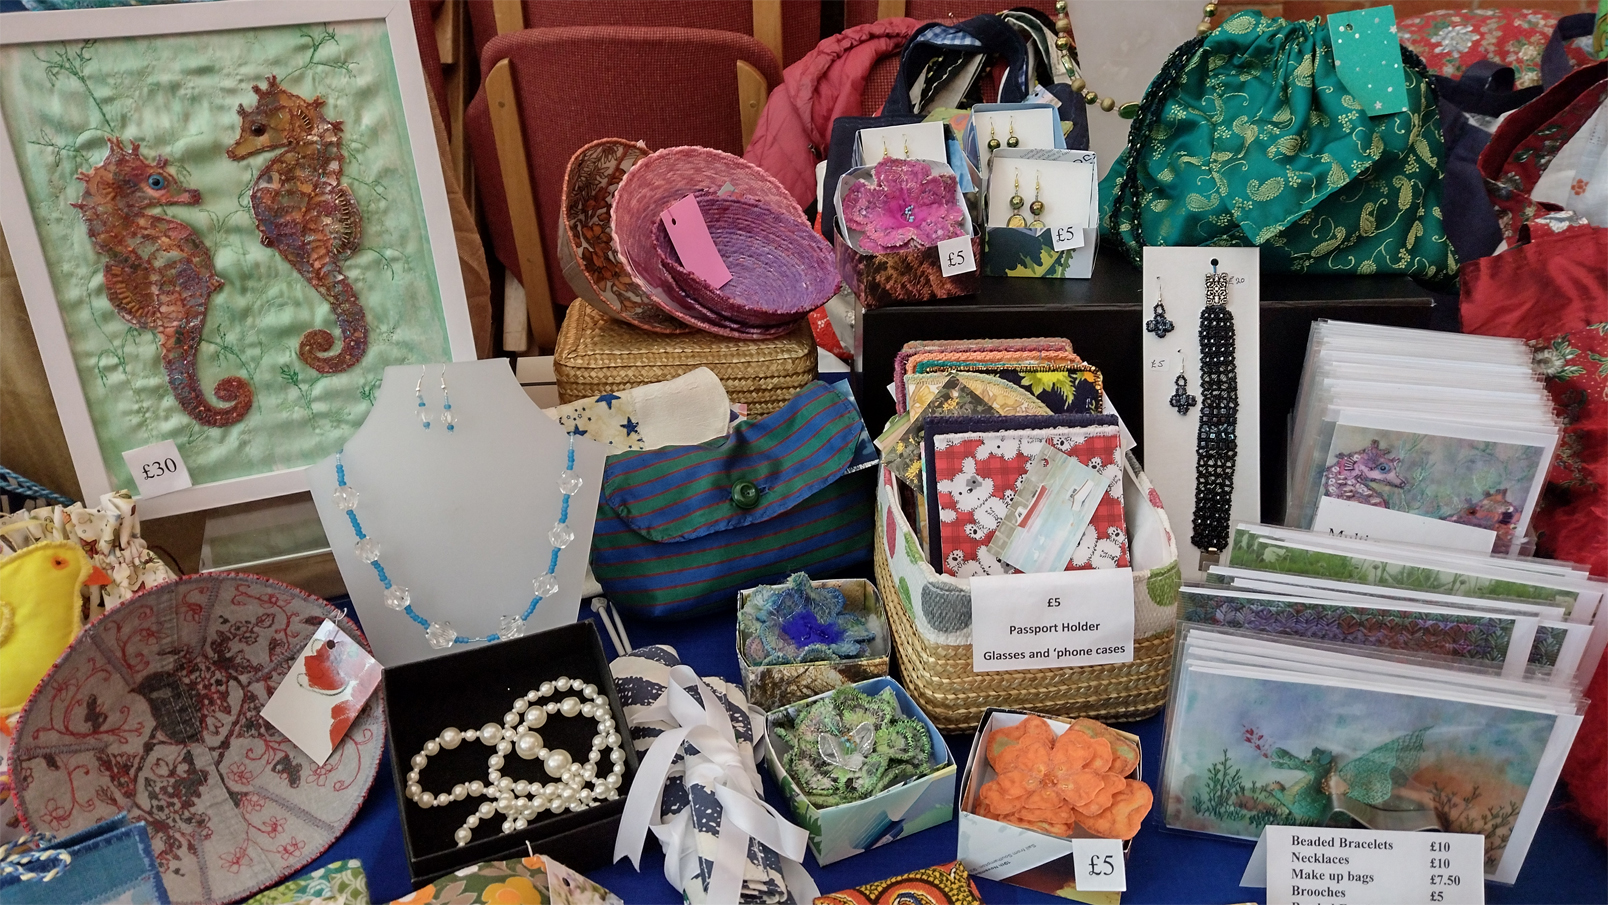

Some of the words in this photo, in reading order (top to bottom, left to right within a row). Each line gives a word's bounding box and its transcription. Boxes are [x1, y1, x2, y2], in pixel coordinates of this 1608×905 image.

[1056, 226, 1075, 242] £5
[947, 250, 965, 267] £5
[1151, 359, 1165, 368] £5
[142, 457, 177, 480] £30
[1047, 597, 1061, 608] £5
[1009, 623, 1058, 636] Passport
[1062, 621, 1101, 633] Holder
[983, 650, 1026, 661] Glasses
[1029, 648, 1050, 658] and
[1095, 645, 1126, 655] cases
[1291, 835, 1335, 848] Beaded
[1339, 837, 1394, 850] Bracelets
[1430, 841, 1451, 852] £10
[1088, 855, 1115, 875] £5
[1291, 852, 1350, 865] Necklaces
[1430, 858, 1451, 869] £10
[1291, 868, 1325, 881] Make
[1329, 872, 1344, 884] up
[1347, 871, 1374, 885] bags
[1430, 874, 1461, 886] £7.50
[1291, 885, 1346, 898] Brooches
[1430, 891, 1444, 902] £5
